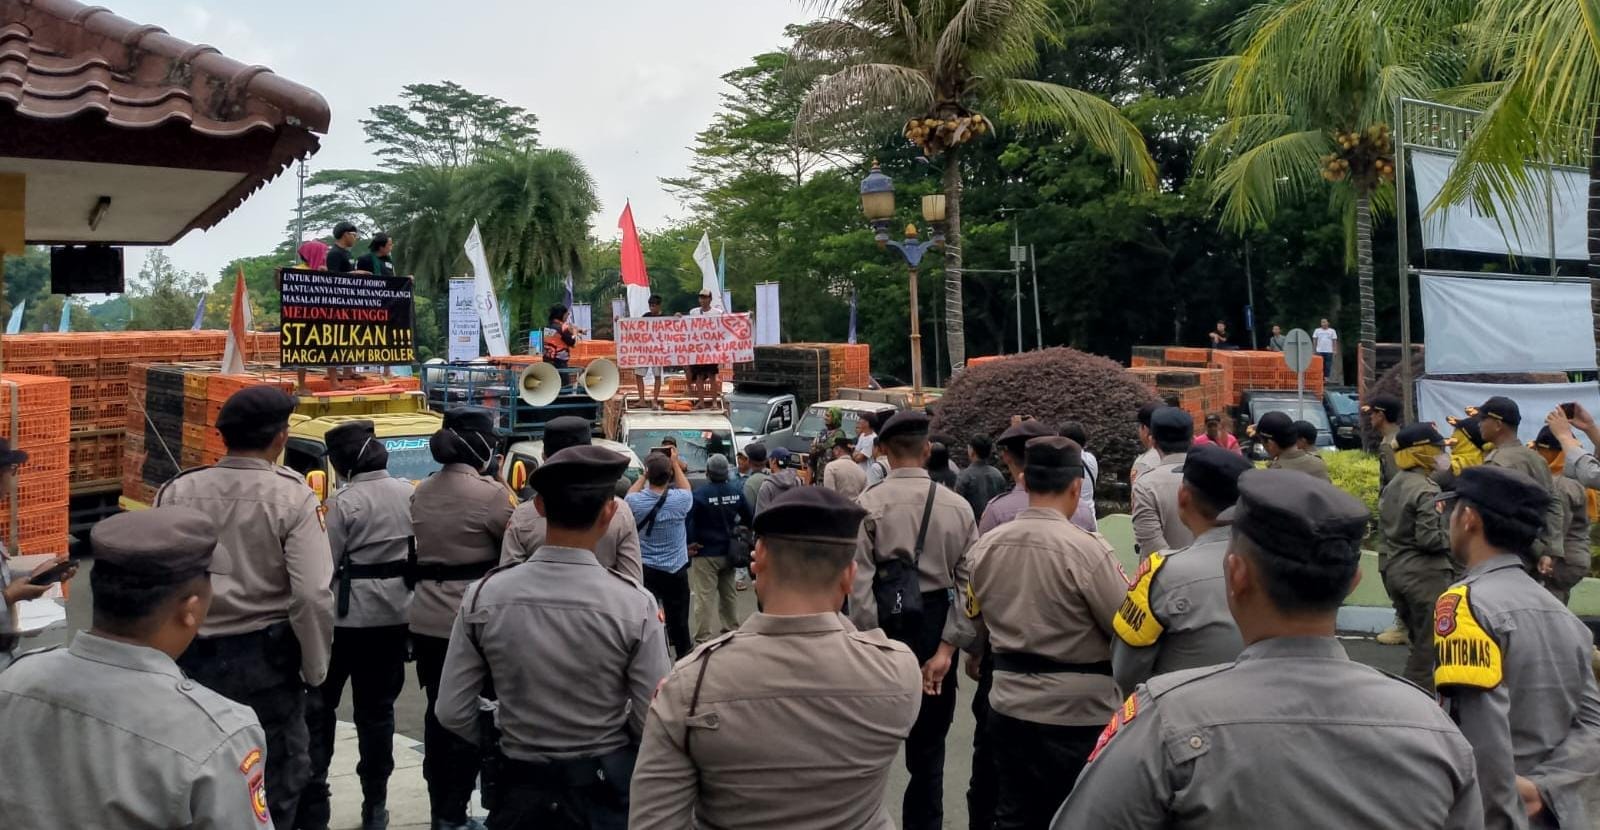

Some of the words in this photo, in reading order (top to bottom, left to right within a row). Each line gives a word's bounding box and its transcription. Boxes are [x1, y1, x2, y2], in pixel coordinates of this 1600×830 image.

[283, 272, 310, 282] UNTUK
[312, 274, 332, 284] DINAS
[334, 276, 363, 286] TERKAIT
[364, 279, 386, 288] MOHON
[283, 283, 333, 294] BANTUANNYA
[334, 286, 356, 296] UNTUK
[357, 288, 411, 299] MENANGGULANGI
[282, 294, 320, 304] MASALAH
[321, 296, 346, 305] HARGA
[346, 298, 364, 306] AYAM
[364, 299, 382, 307] YANG
[283, 306, 349, 320] MELONJAK
[352, 308, 389, 321] TINGGI
[620, 320, 649, 331] NKRI
[652, 319, 688, 332] HARGA
[282, 323, 387, 346] STABILKAN
[620, 332, 654, 343] HARGA
[282, 348, 326, 363] HARGA
[330, 348, 365, 363] AYAM
[368, 348, 415, 362] BROILER
[674, 343, 711, 354] HARGA
[620, 355, 672, 366] SEDANG
[677, 355, 690, 366] DI
